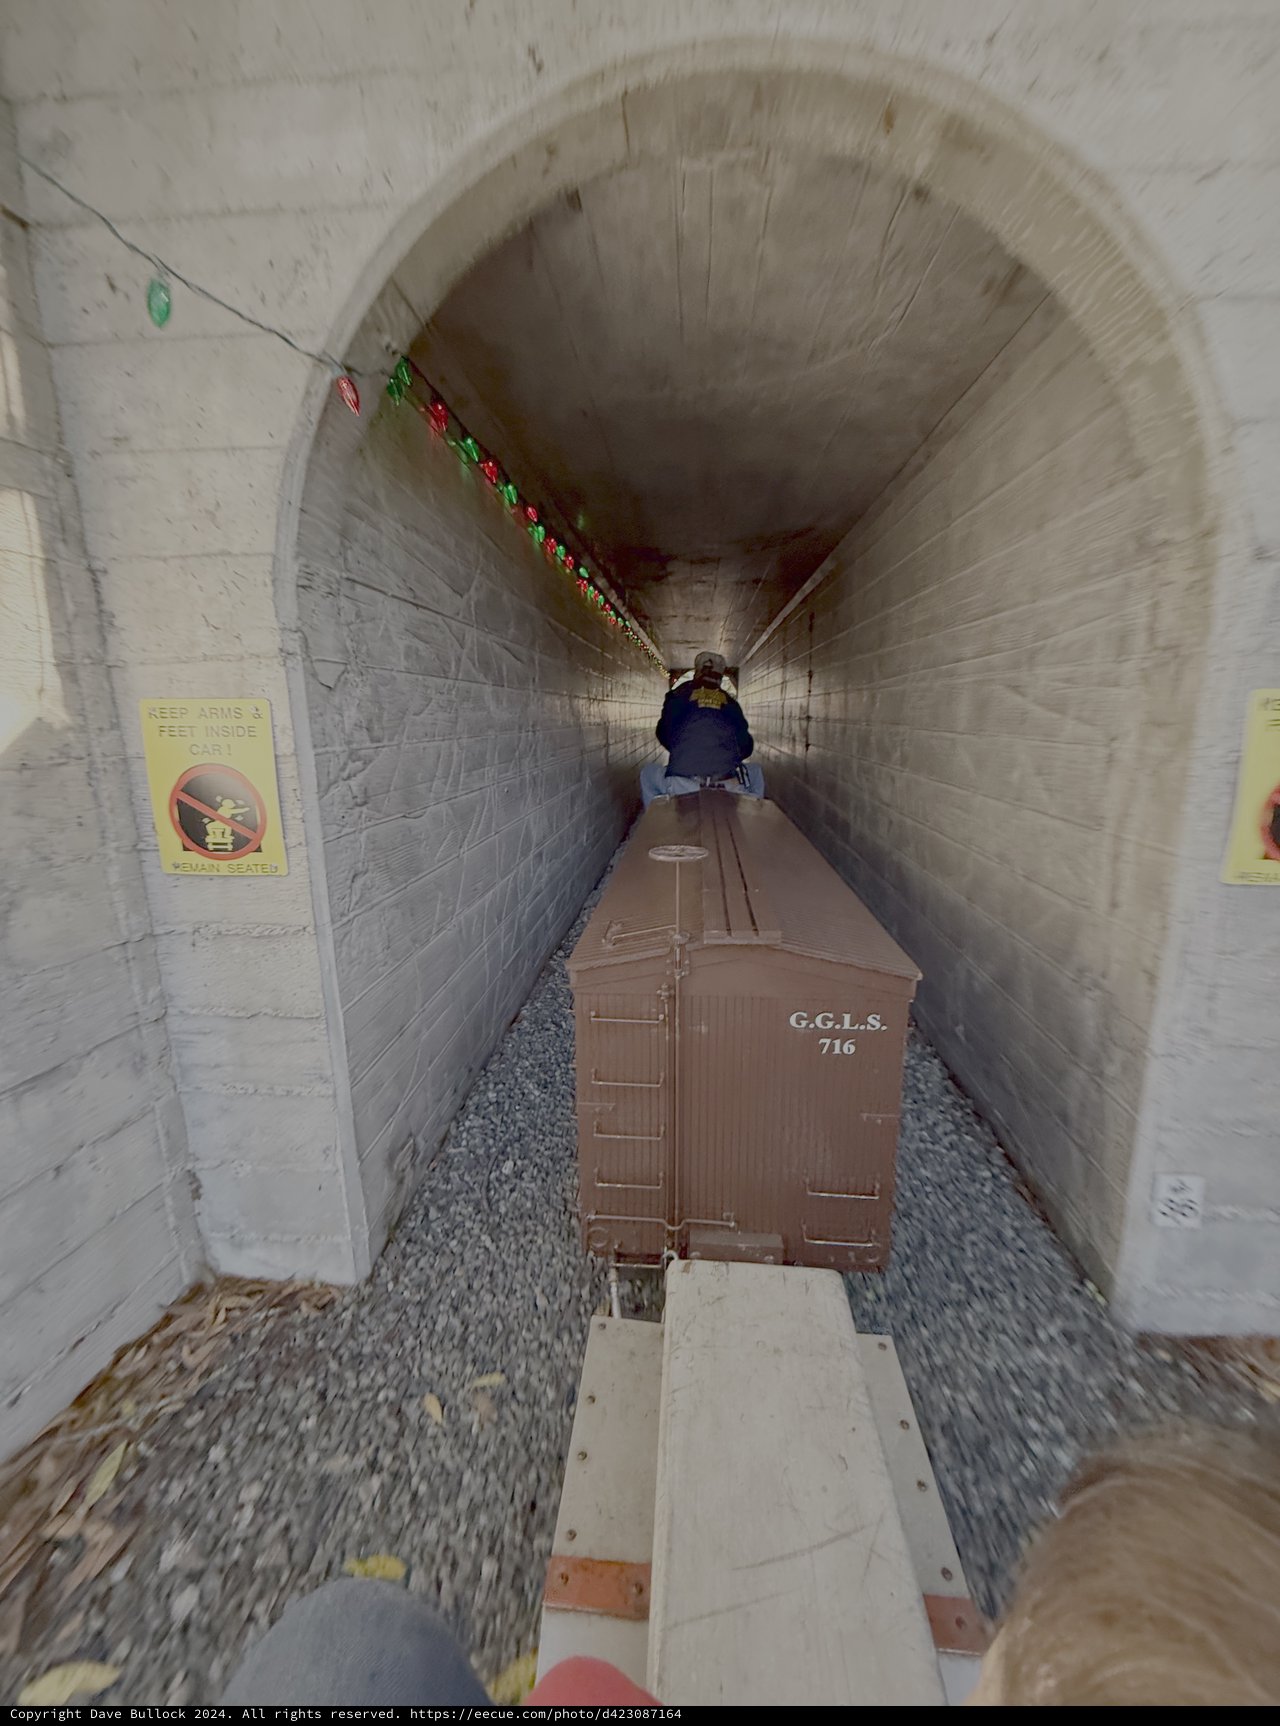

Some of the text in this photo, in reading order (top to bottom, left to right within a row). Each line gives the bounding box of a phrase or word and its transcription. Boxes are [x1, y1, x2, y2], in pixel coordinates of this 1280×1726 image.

[148, 707, 188, 719] KEEP
[199, 707, 242, 719] ARMS
[158, 725, 256, 737] FEET INSIDE
[789, 1011, 888, 1030] G.G.L.S.
[819, 1038, 856, 1055] 716
